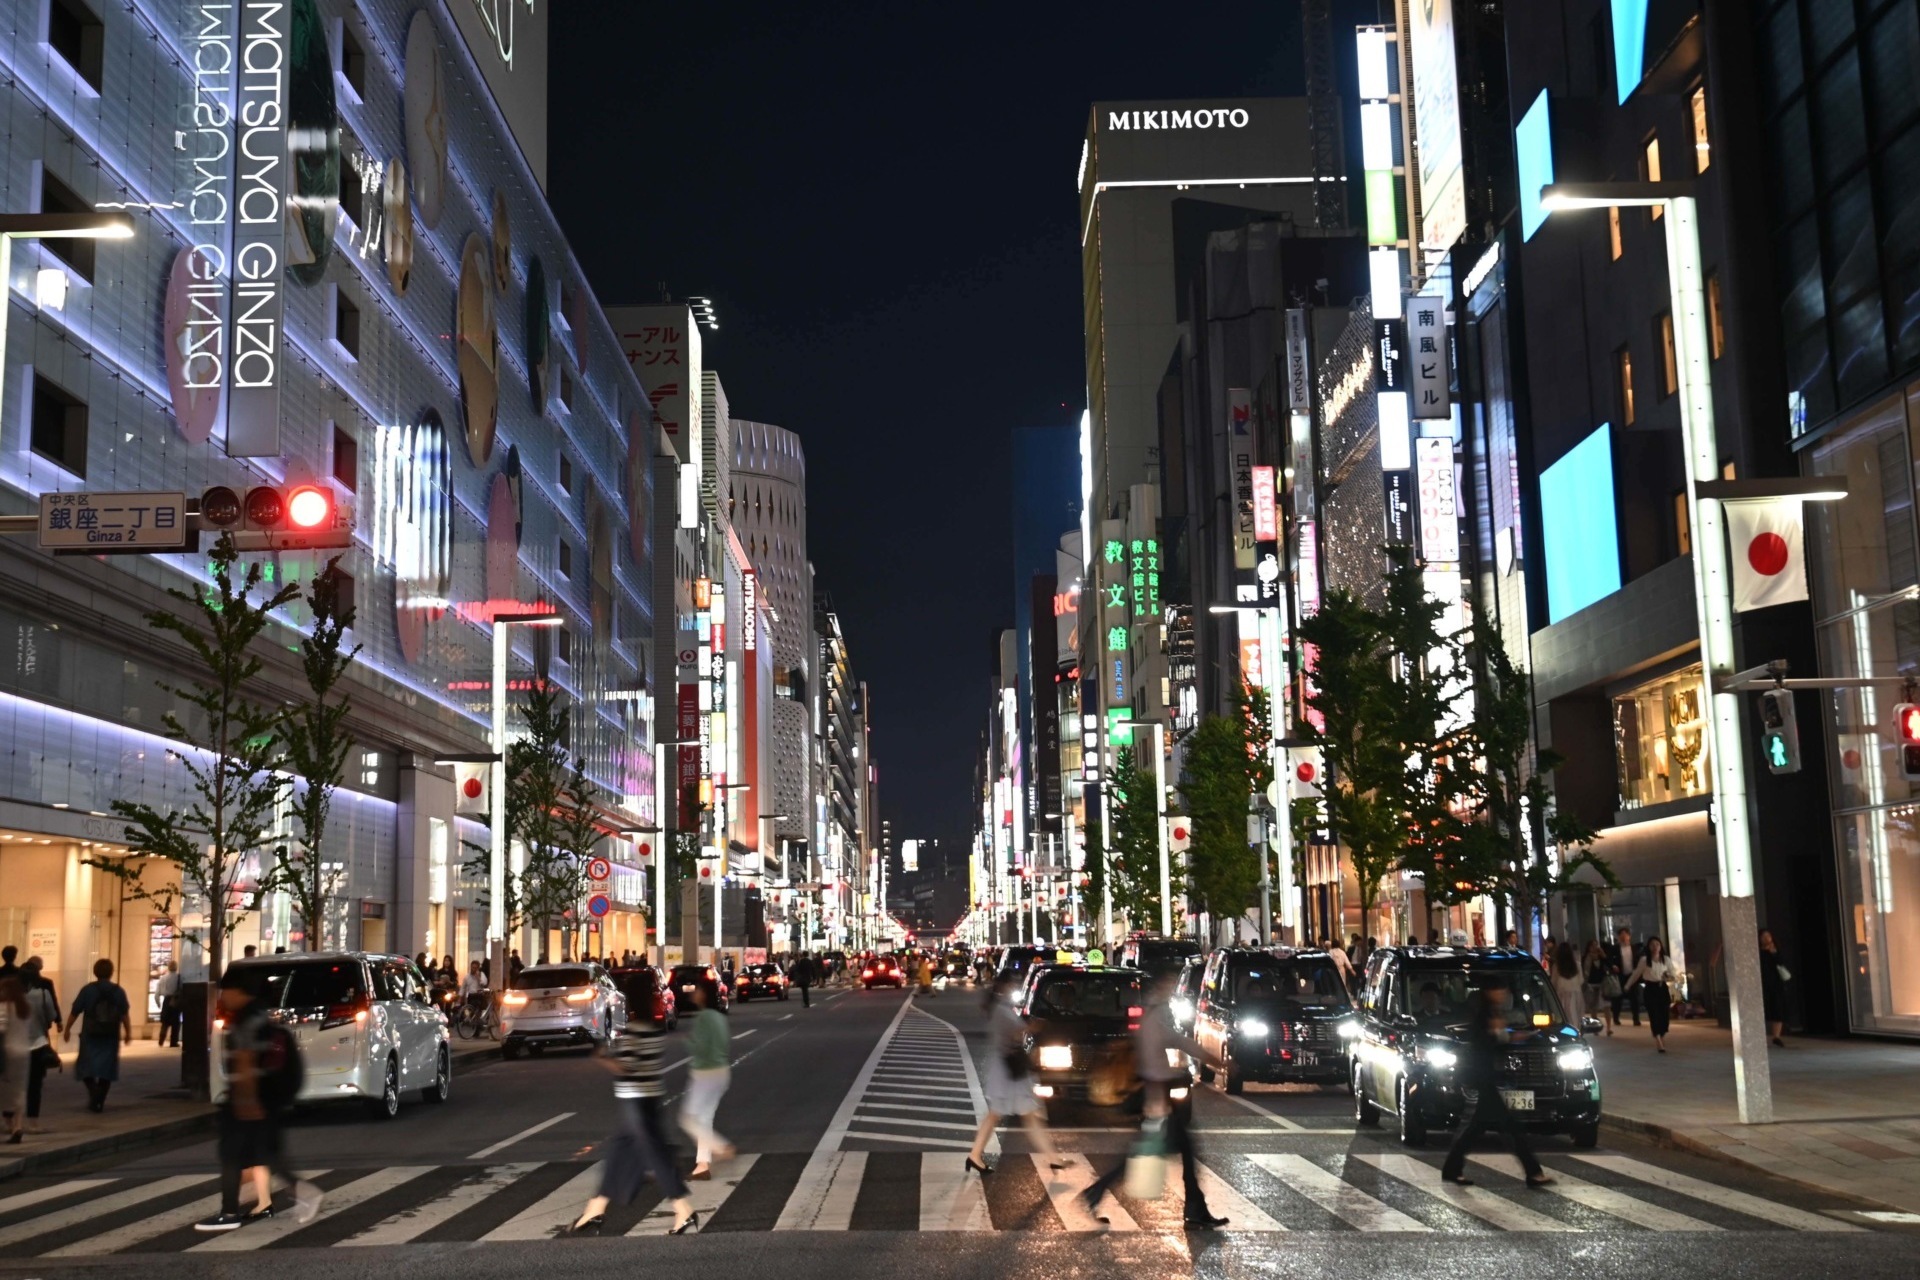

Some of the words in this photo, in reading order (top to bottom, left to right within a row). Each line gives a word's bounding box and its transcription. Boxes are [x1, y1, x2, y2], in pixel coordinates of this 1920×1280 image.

[1108, 108, 1250, 131] MIKIMOTO
[234, 241, 278, 389] GINZA
[615, 326, 681, 345] ーアル
[1417, 309, 1440, 406] 南風ビル
[48, 506, 176, 530] 銀座二丁目
[49, 494, 90, 506] 中央区
[1236, 452, 1256, 550] 日本香堂ビル
[86, 529, 123, 543] Ginza
[127, 529, 137, 542] 2
[1104, 540, 1127, 652] 教文館
[1131, 540, 1146, 617] 教文館ビル
[1146, 539, 1160, 616] 教文館ビル
[743, 573, 756, 651] MITSUKOSHI
[1114, 659, 1123, 682] SINCE
[1028, 786, 1036, 816] TASAKI
